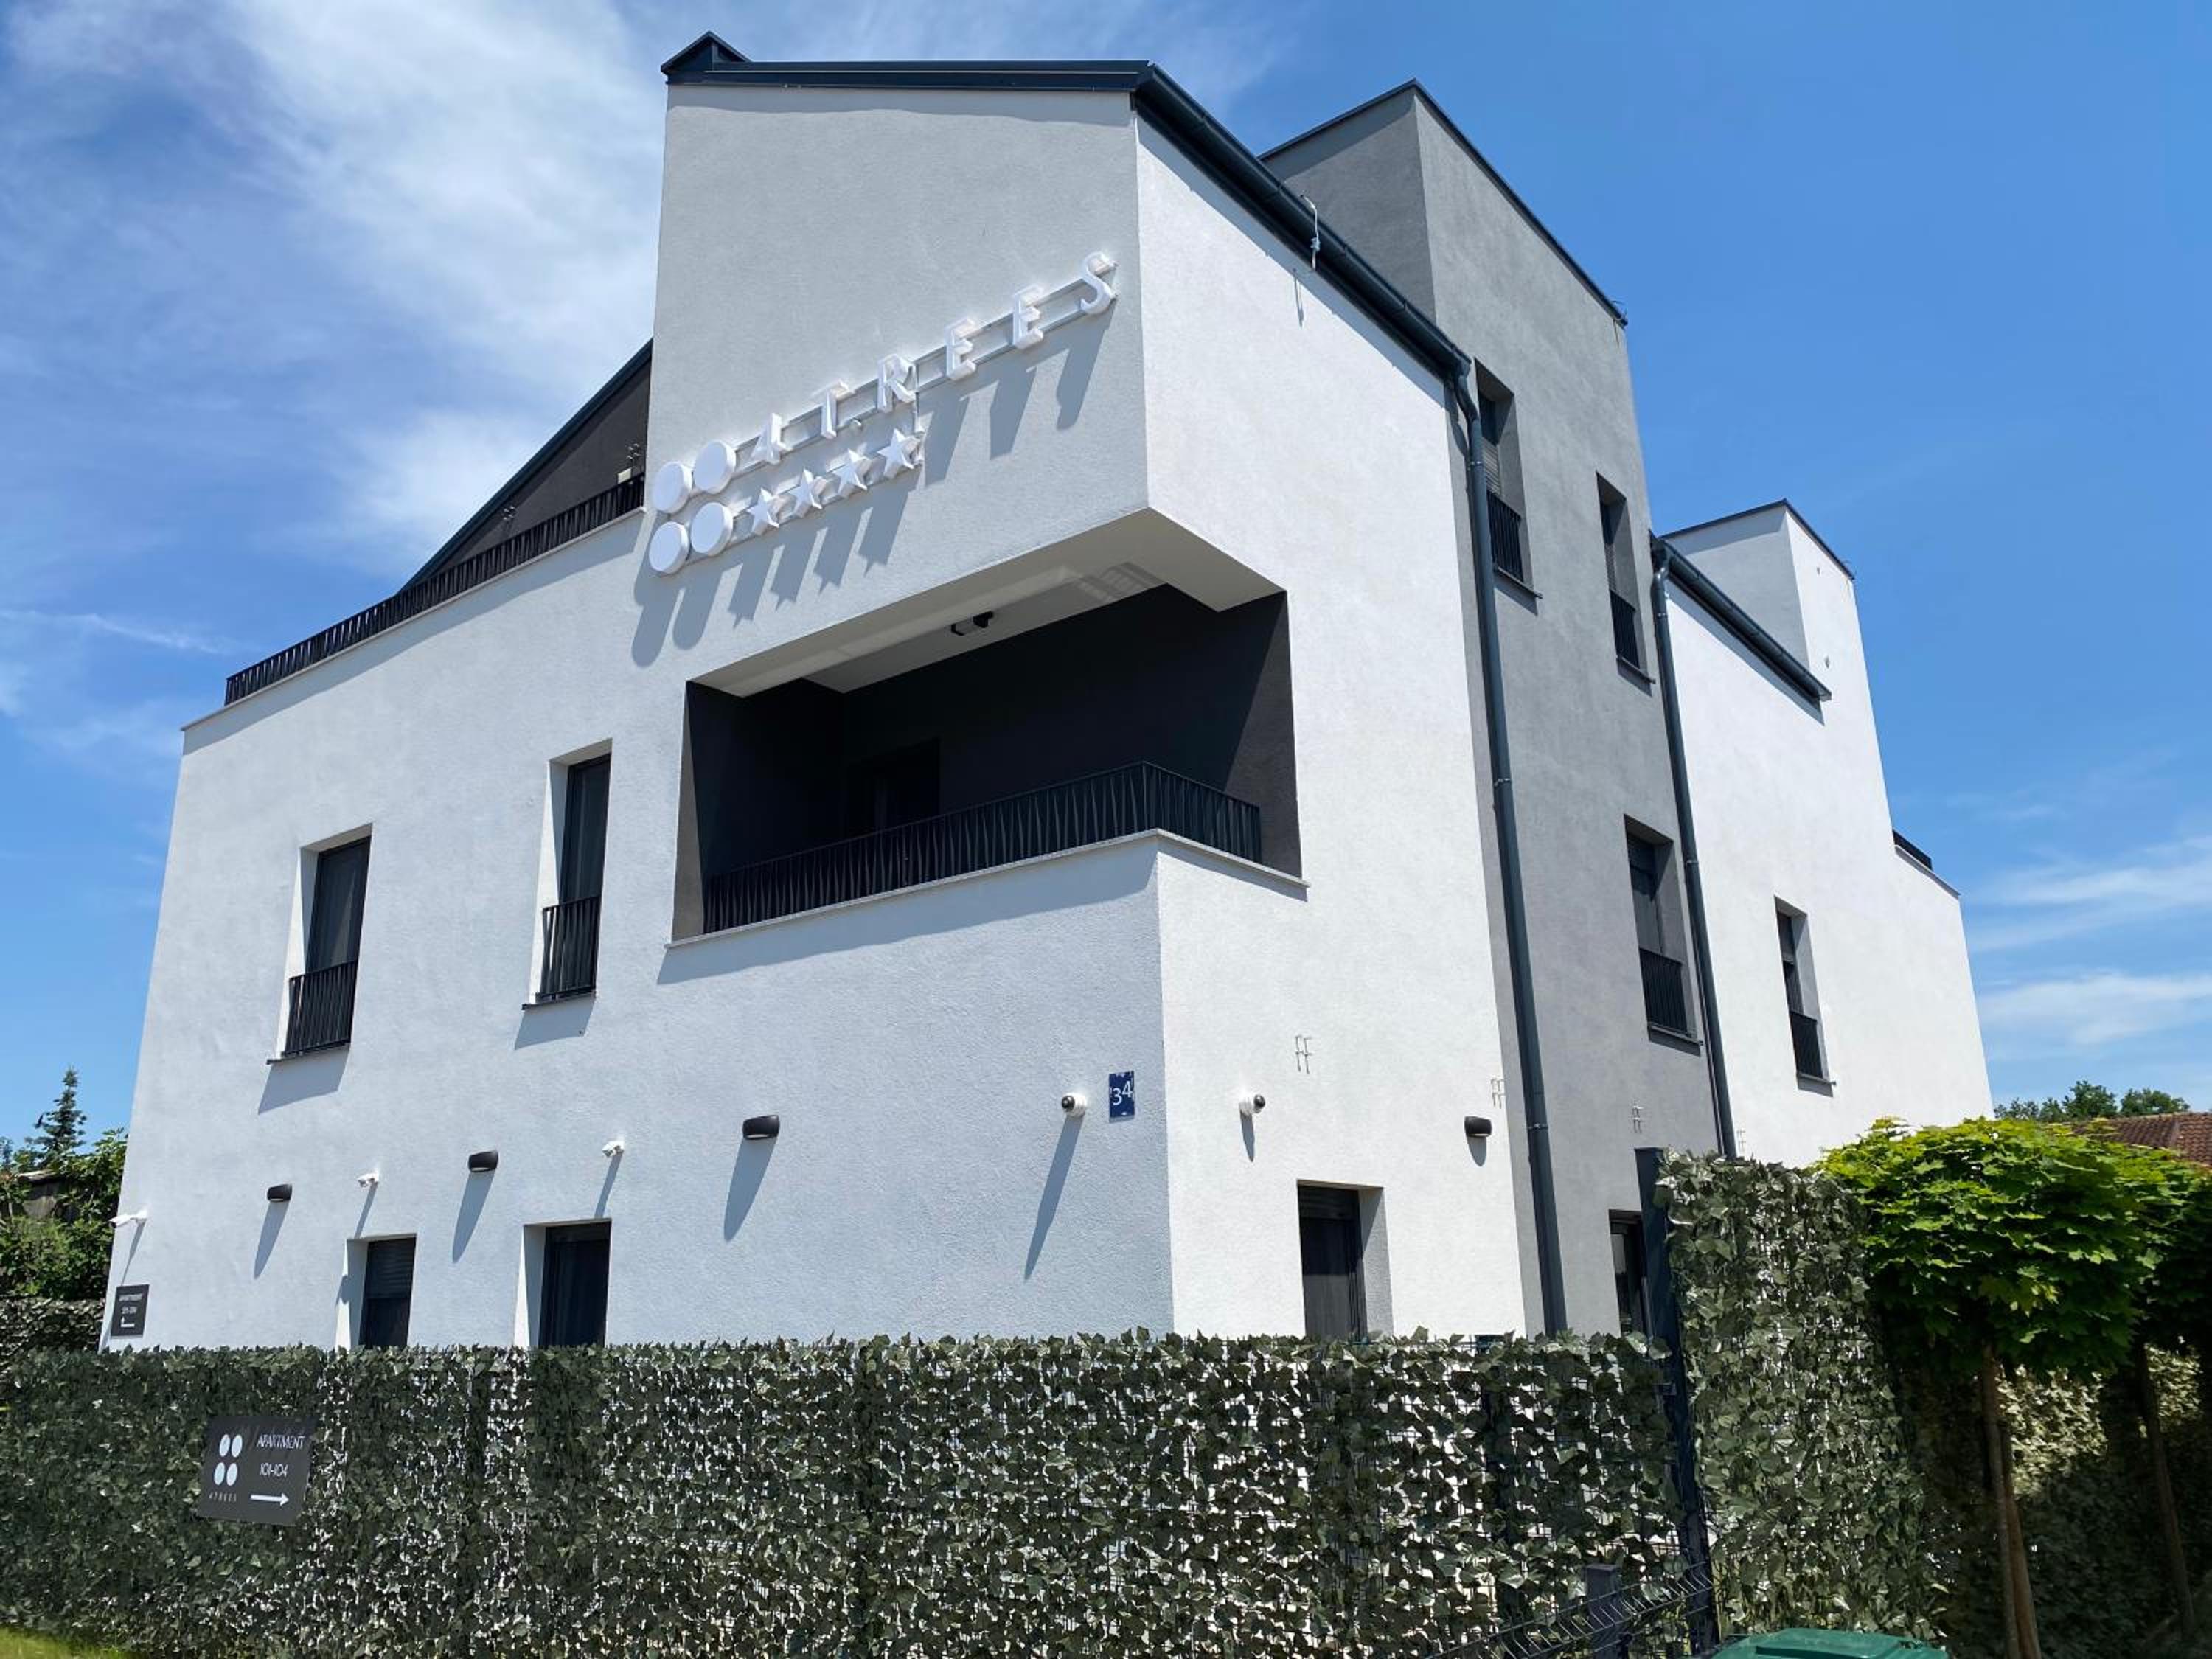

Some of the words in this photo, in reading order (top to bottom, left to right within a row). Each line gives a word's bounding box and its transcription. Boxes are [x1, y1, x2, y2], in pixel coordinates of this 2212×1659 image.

[749, 251, 1117, 466] 4TREES
[1113, 1080, 1133, 1106] 34
[256, 1433, 306, 1450] APARTMENT
